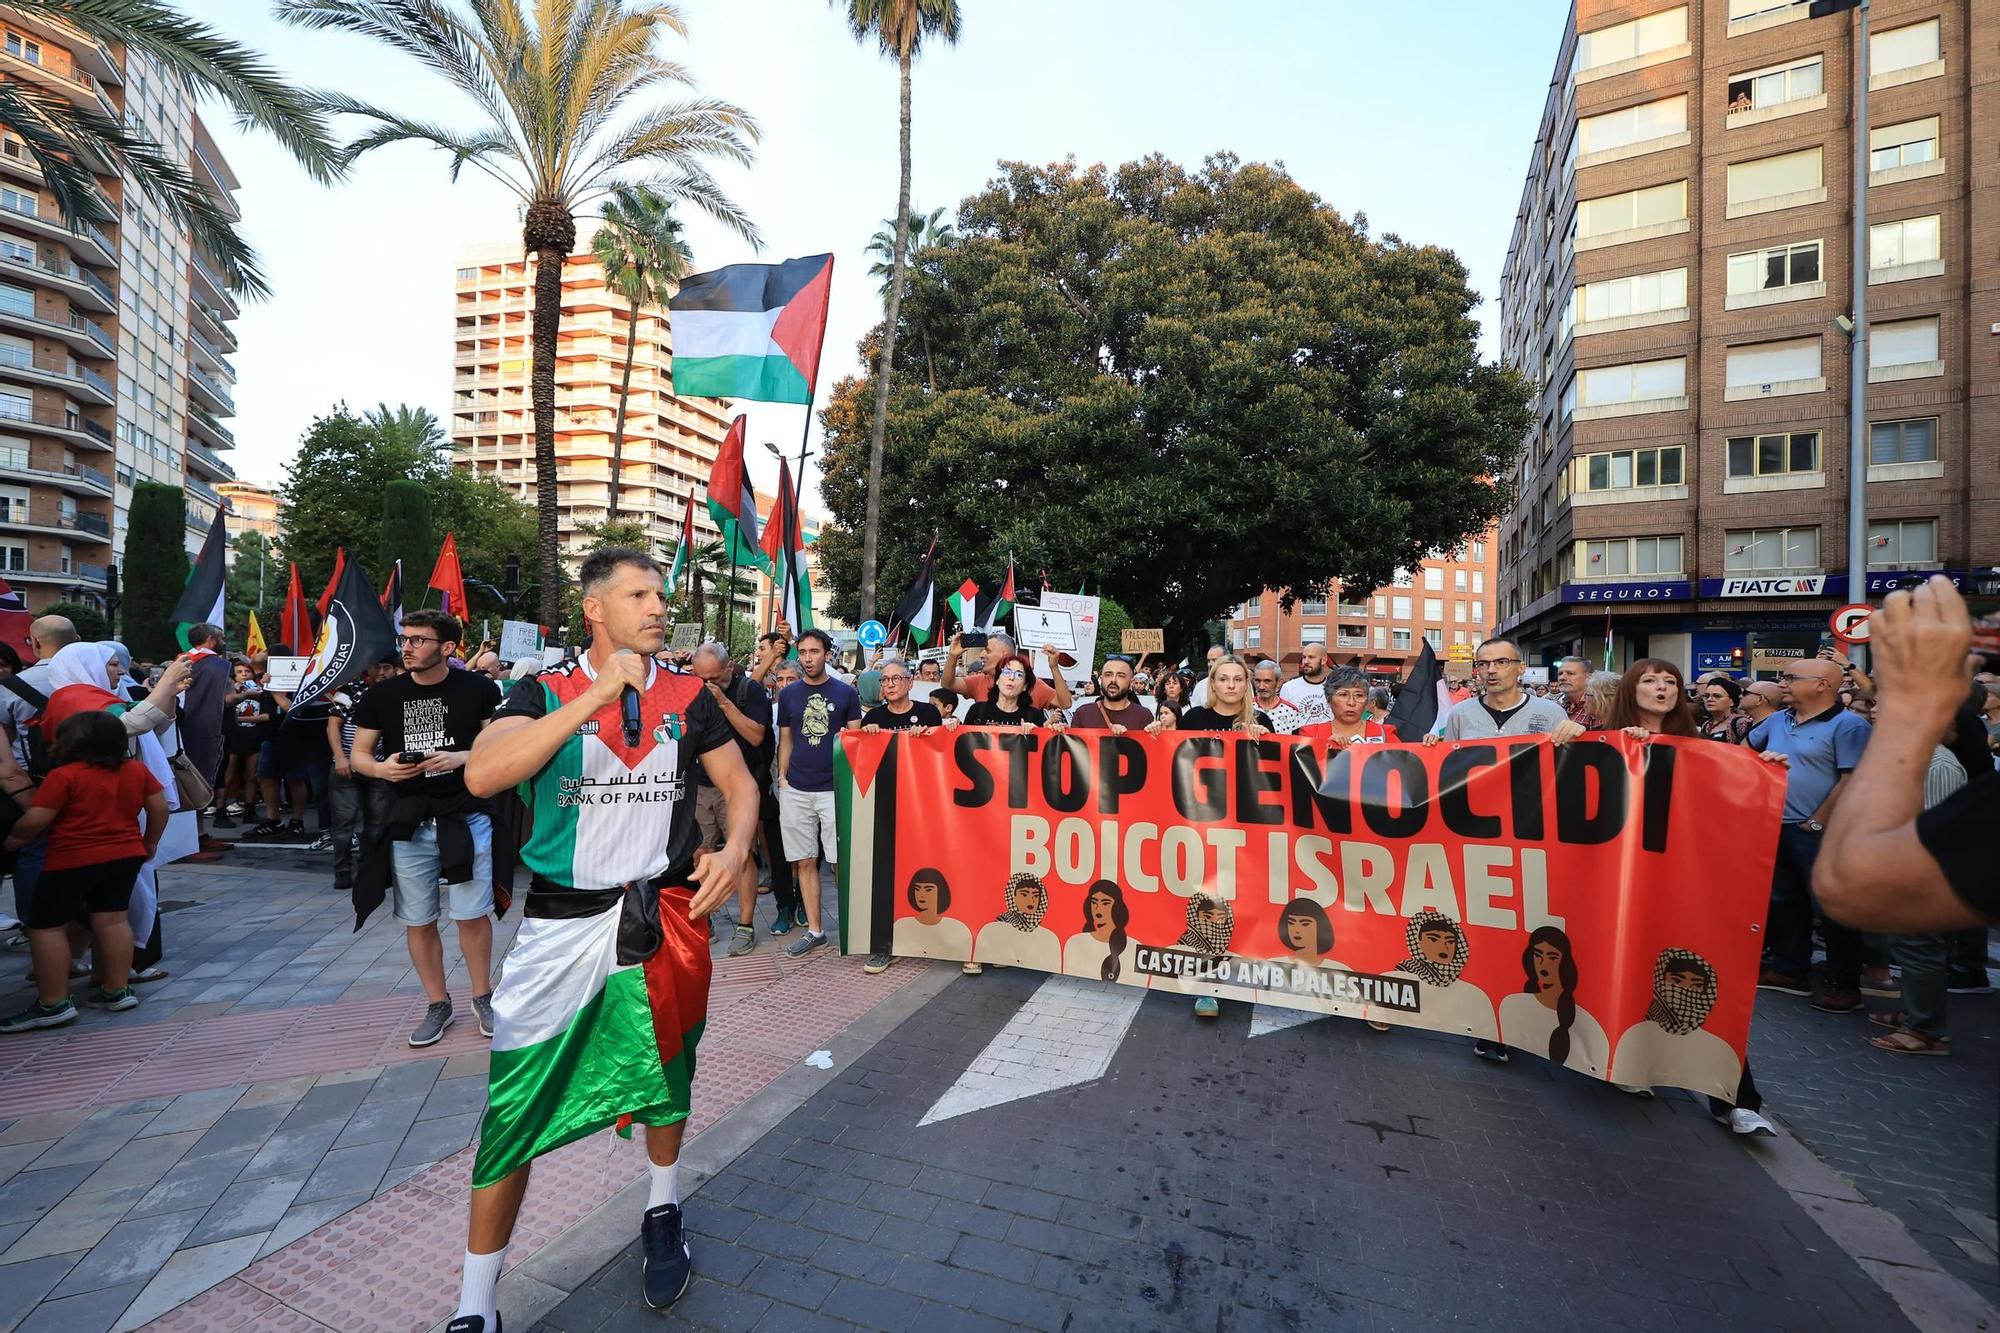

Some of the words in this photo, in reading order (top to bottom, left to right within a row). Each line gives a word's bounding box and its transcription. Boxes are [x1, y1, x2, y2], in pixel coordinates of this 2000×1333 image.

[1727, 579, 1790, 594] FIATC
[1578, 588, 1672, 600] SEGUROS
[1048, 597, 1093, 613] STOP
[519, 627, 535, 638] FREE
[403, 701, 416, 710] ELS
[416, 698, 442, 709] BANCS
[403, 706, 448, 718] INVERTEIXEN
[433, 714, 443, 722] EN
[404, 732, 434, 743] DEIXEU
[434, 731, 445, 740] DE
[444, 737, 455, 746] LA
[560, 772, 647, 792] فلسطين
[557, 793, 596, 807] BANK
[600, 792, 622, 804] OF
[627, 788, 686, 803] PALESTIN
[953, 732, 1147, 815] STOP
[1171, 738, 1676, 854] GENOCIDI
[1010, 814, 1246, 901] BOICOT
[1267, 831, 1566, 934] ISRAEL
[1136, 949, 1231, 984] CASTELLÓ
[1236, 963, 1285, 986] AMB
[1290, 971, 1416, 1008] PALESTINA
